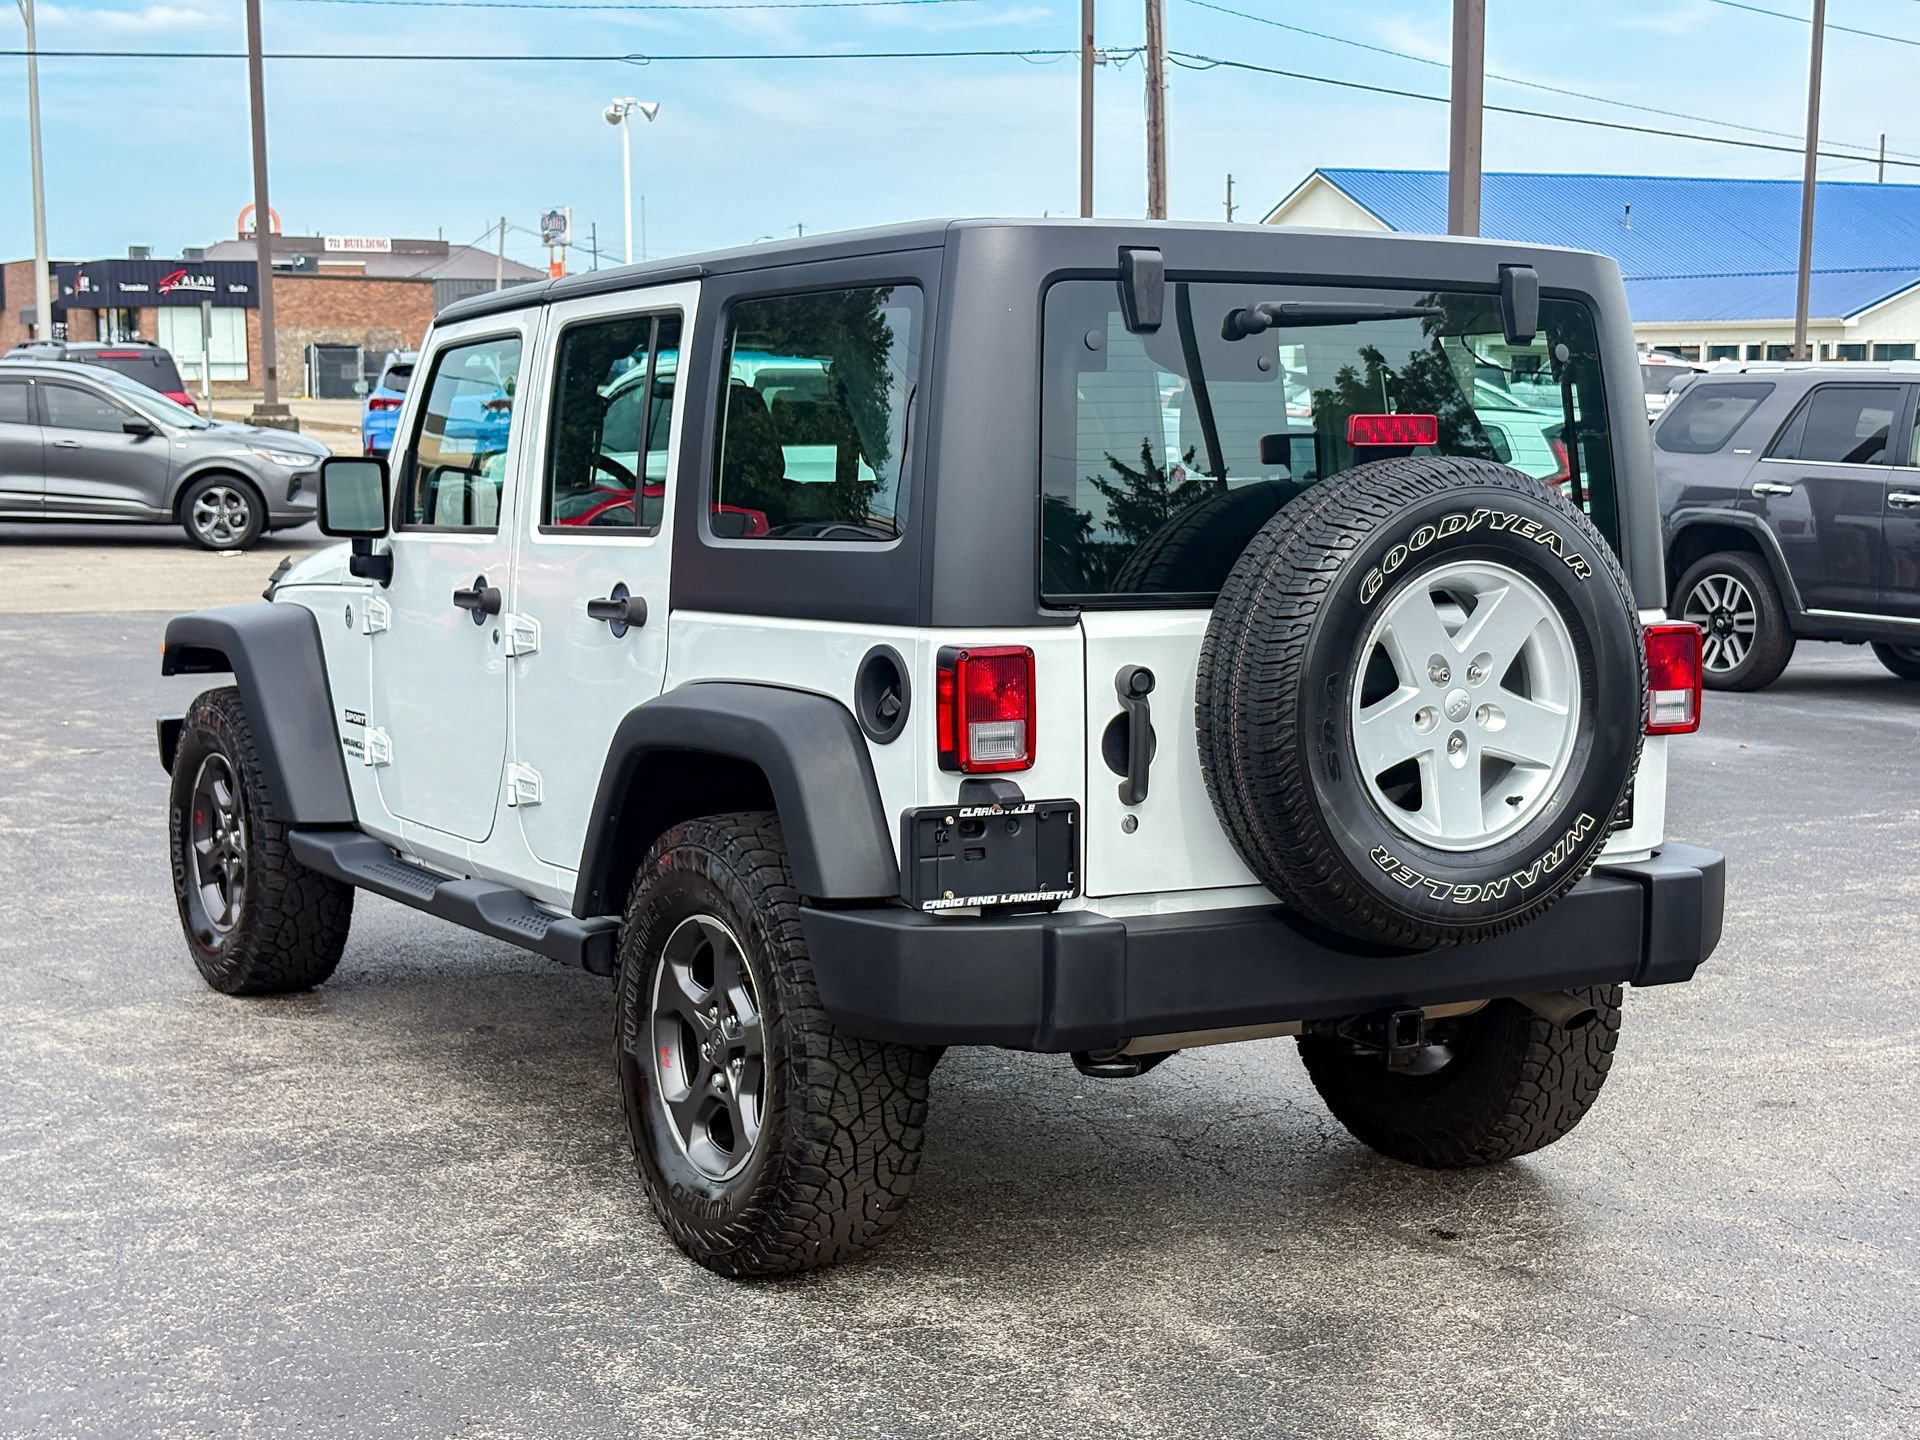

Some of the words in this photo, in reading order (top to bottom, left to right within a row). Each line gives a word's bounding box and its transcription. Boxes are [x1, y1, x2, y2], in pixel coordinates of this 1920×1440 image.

[344, 238, 388, 249] BUILDING
[182, 275, 215, 286] ALAN
[1360, 509, 1592, 604] GOODYEAR
[346, 711, 366, 725] SPORT
[342, 737, 365, 750] WRANGL
[173, 808, 187, 898] KUMHO
[1369, 812, 1596, 904] WRANGLER
[922, 897, 965, 910] CRAIG
[967, 894, 998, 905] AND
[1000, 889, 1074, 902] LANDRETH
[623, 985, 640, 1056] ROAD
